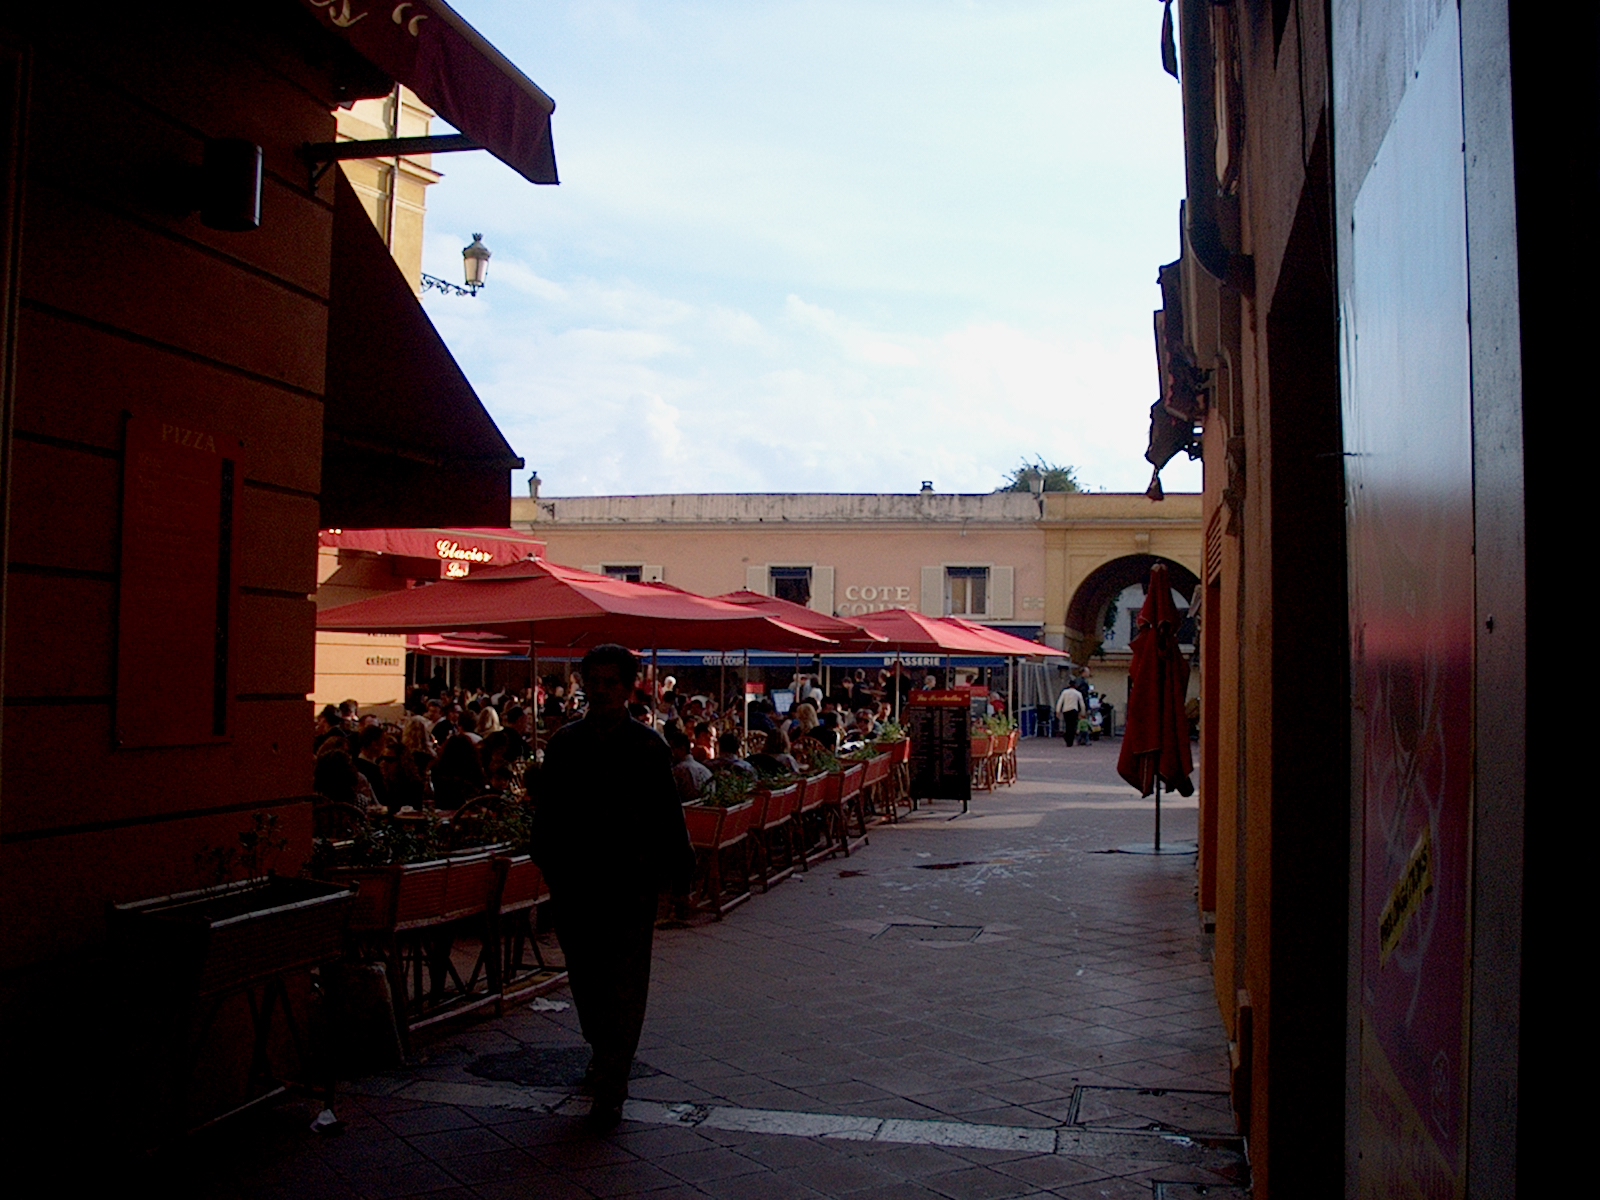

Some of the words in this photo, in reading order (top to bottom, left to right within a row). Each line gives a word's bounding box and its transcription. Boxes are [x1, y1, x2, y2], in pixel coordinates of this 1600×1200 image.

[162, 424, 216, 453] PIZZA
[436, 540, 493, 562] Glacier
[845, 586, 910, 601] COTE
